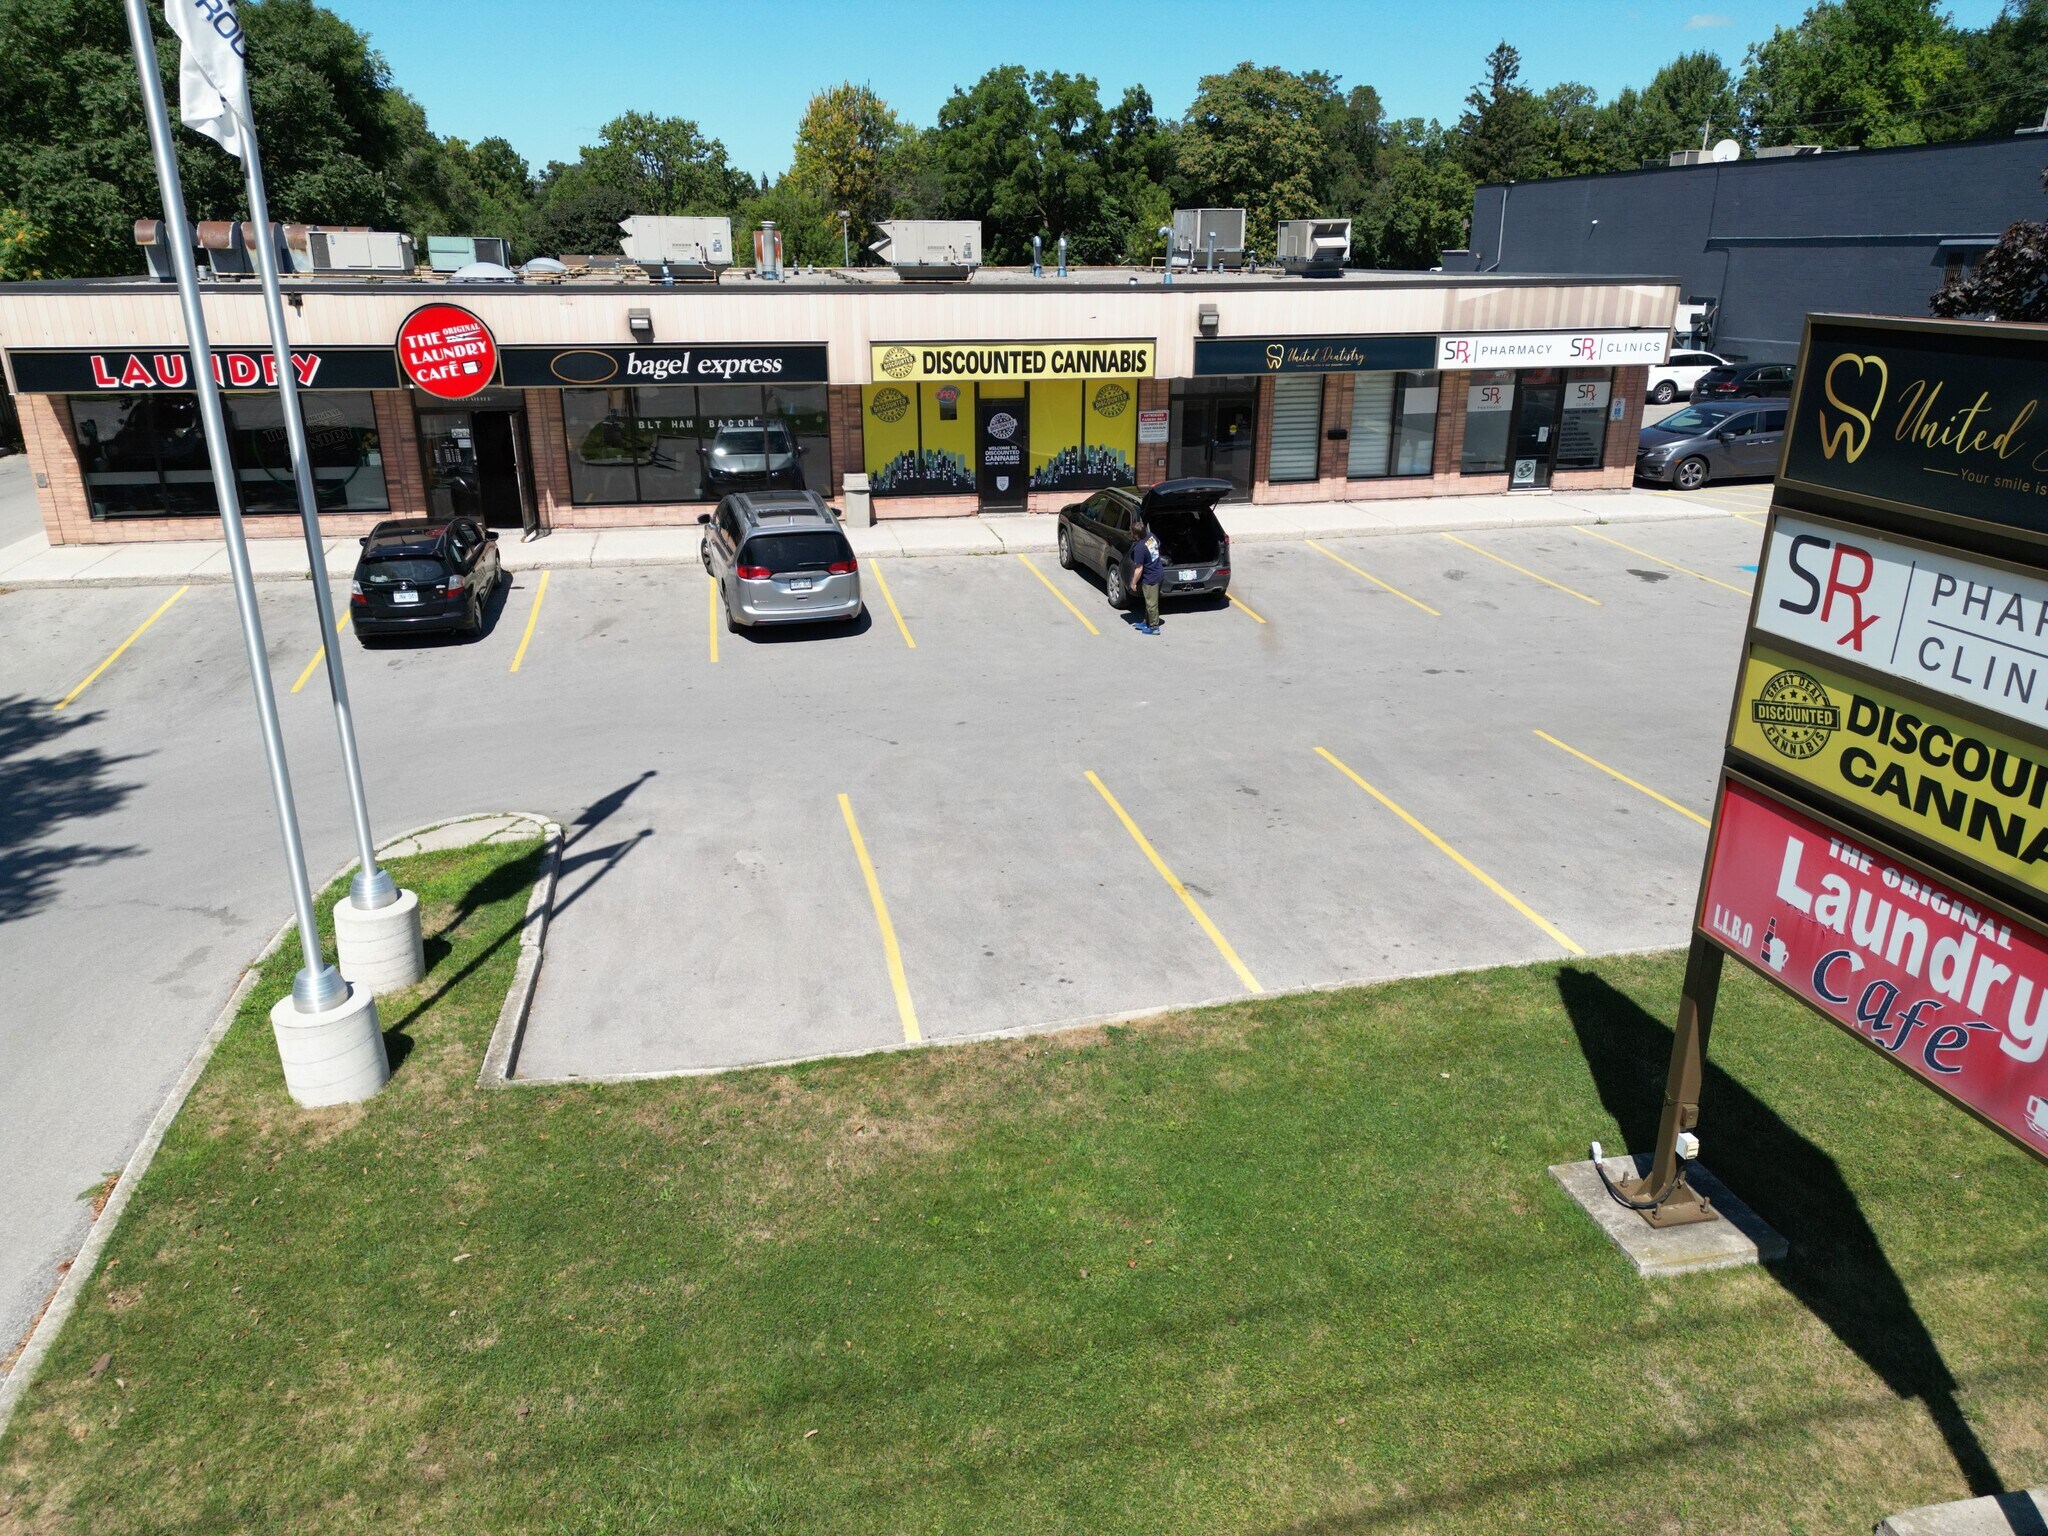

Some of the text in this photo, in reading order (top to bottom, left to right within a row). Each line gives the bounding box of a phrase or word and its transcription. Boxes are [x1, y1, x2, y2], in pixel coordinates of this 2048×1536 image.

[404, 323, 480, 348] THE ORIGINAL
[410, 341, 487, 365] LAUNDRY
[923, 350, 1147, 374] DISCOUNTED CANNABIS
[1288, 346, 1366, 366] United Dentistry
[1481, 345, 1553, 356] PHARMACY
[1607, 342, 1661, 353] CLINICS
[627, 351, 783, 380] bagel express
[638, 418, 755, 429] BLT HAM BACON
[1895, 379, 2037, 460] United
[1960, 468, 1989, 485] Your
[1994, 476, 2030, 492] smile
[1918, 636, 2048, 712] CLIN
[1766, 674, 1822, 702] GREAT DEAL
[1758, 705, 1833, 726] DISCOUNTED
[1766, 726, 1825, 755] CANNABIS
[1828, 837, 2012, 951] THE ORIGINAL
[1776, 835, 2048, 1063] Laundry
[1812, 949, 2002, 1074] Café
